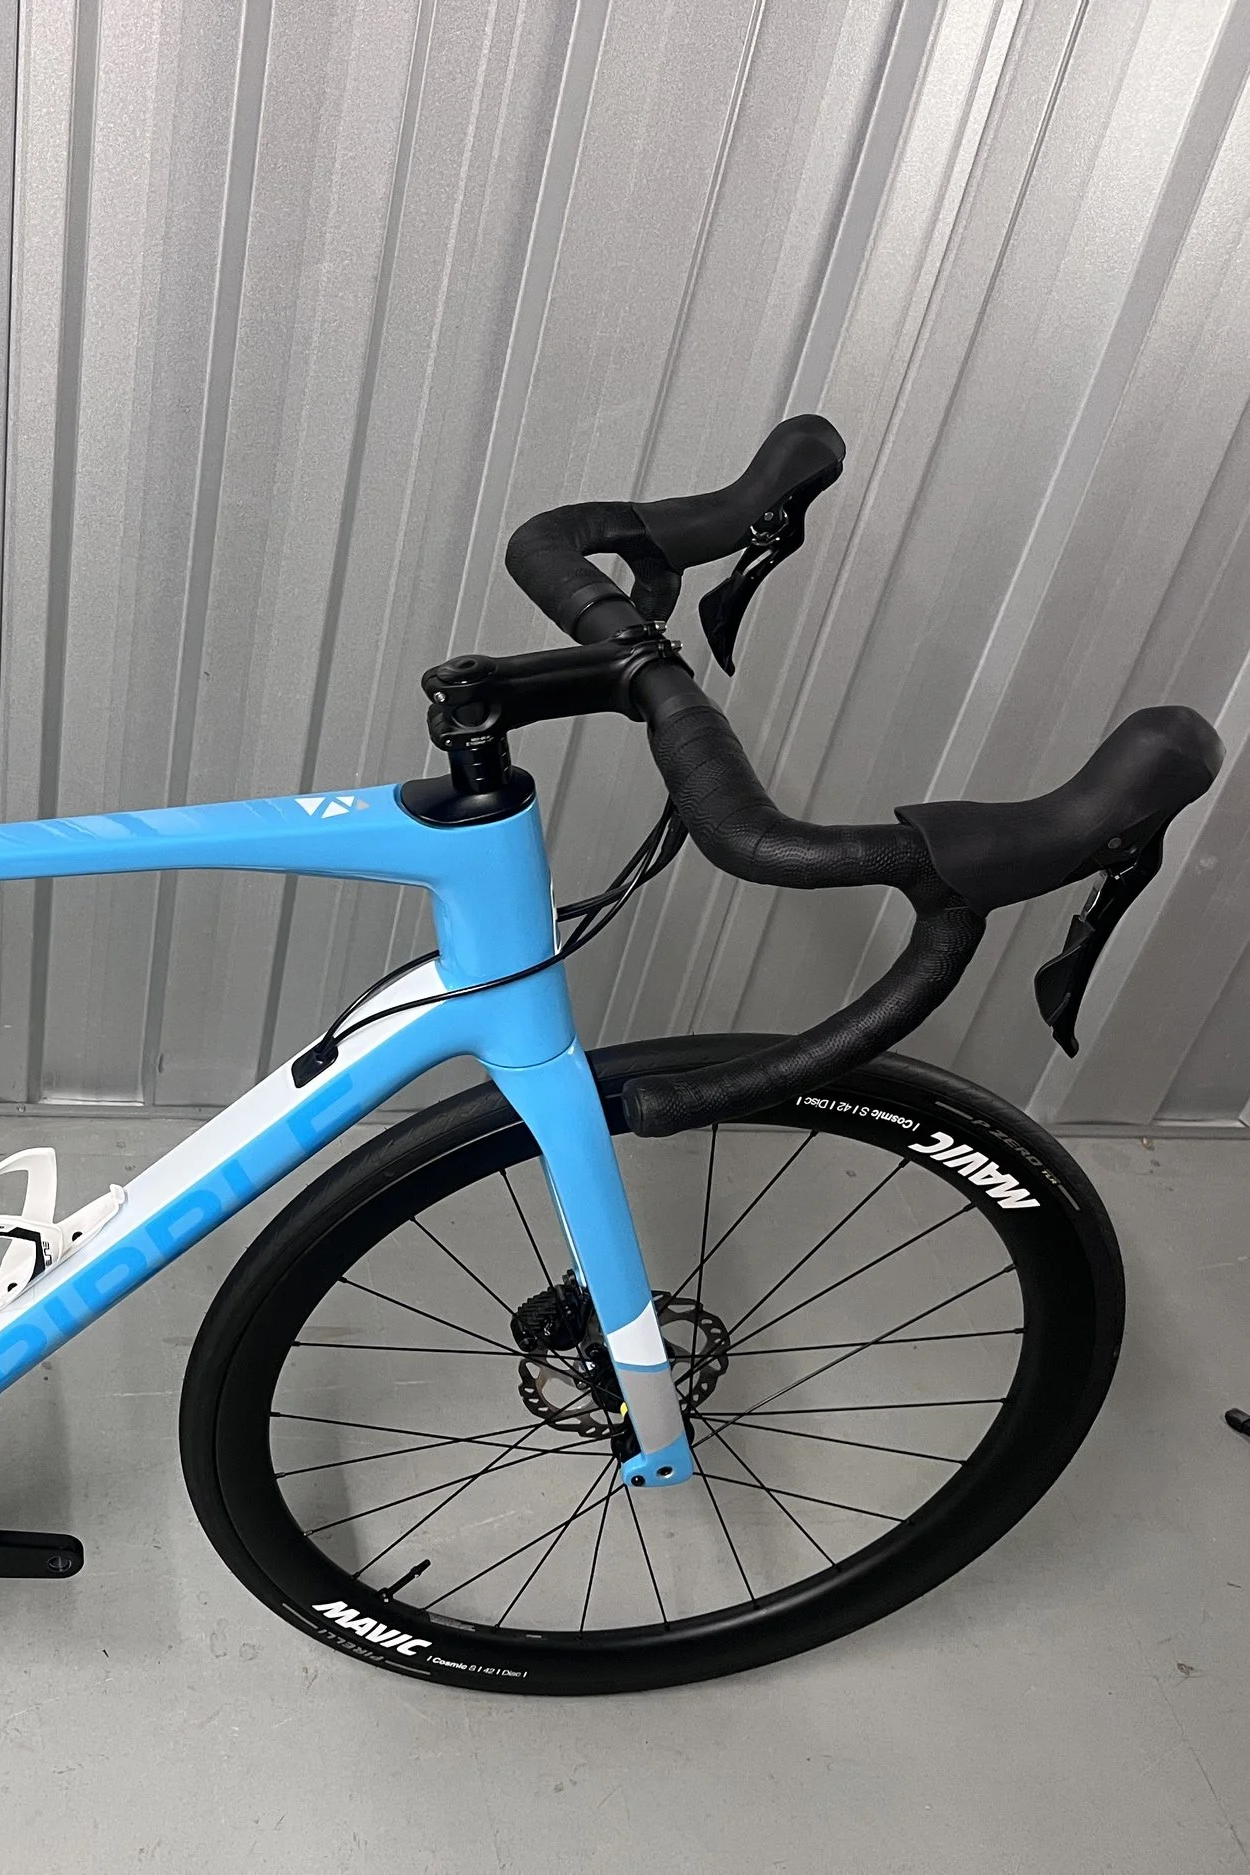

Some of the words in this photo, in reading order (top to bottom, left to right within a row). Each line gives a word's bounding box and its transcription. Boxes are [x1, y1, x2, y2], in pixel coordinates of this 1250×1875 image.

[803, 1096, 830, 1109] Disc
[836, 1101, 852, 1112] 42
[858, 1106, 870, 1117] S
[870, 1109, 914, 1129] Cosmic
[989, 1130, 1043, 1166] ZERO
[907, 1131, 1041, 1209] MAVIC
[311, 1600, 433, 1657] MAVIC
[317, 1628, 385, 1662] PIRELLI
[432, 1656, 468, 1670] Cosmic
[483, 1667, 496, 1675] 42
